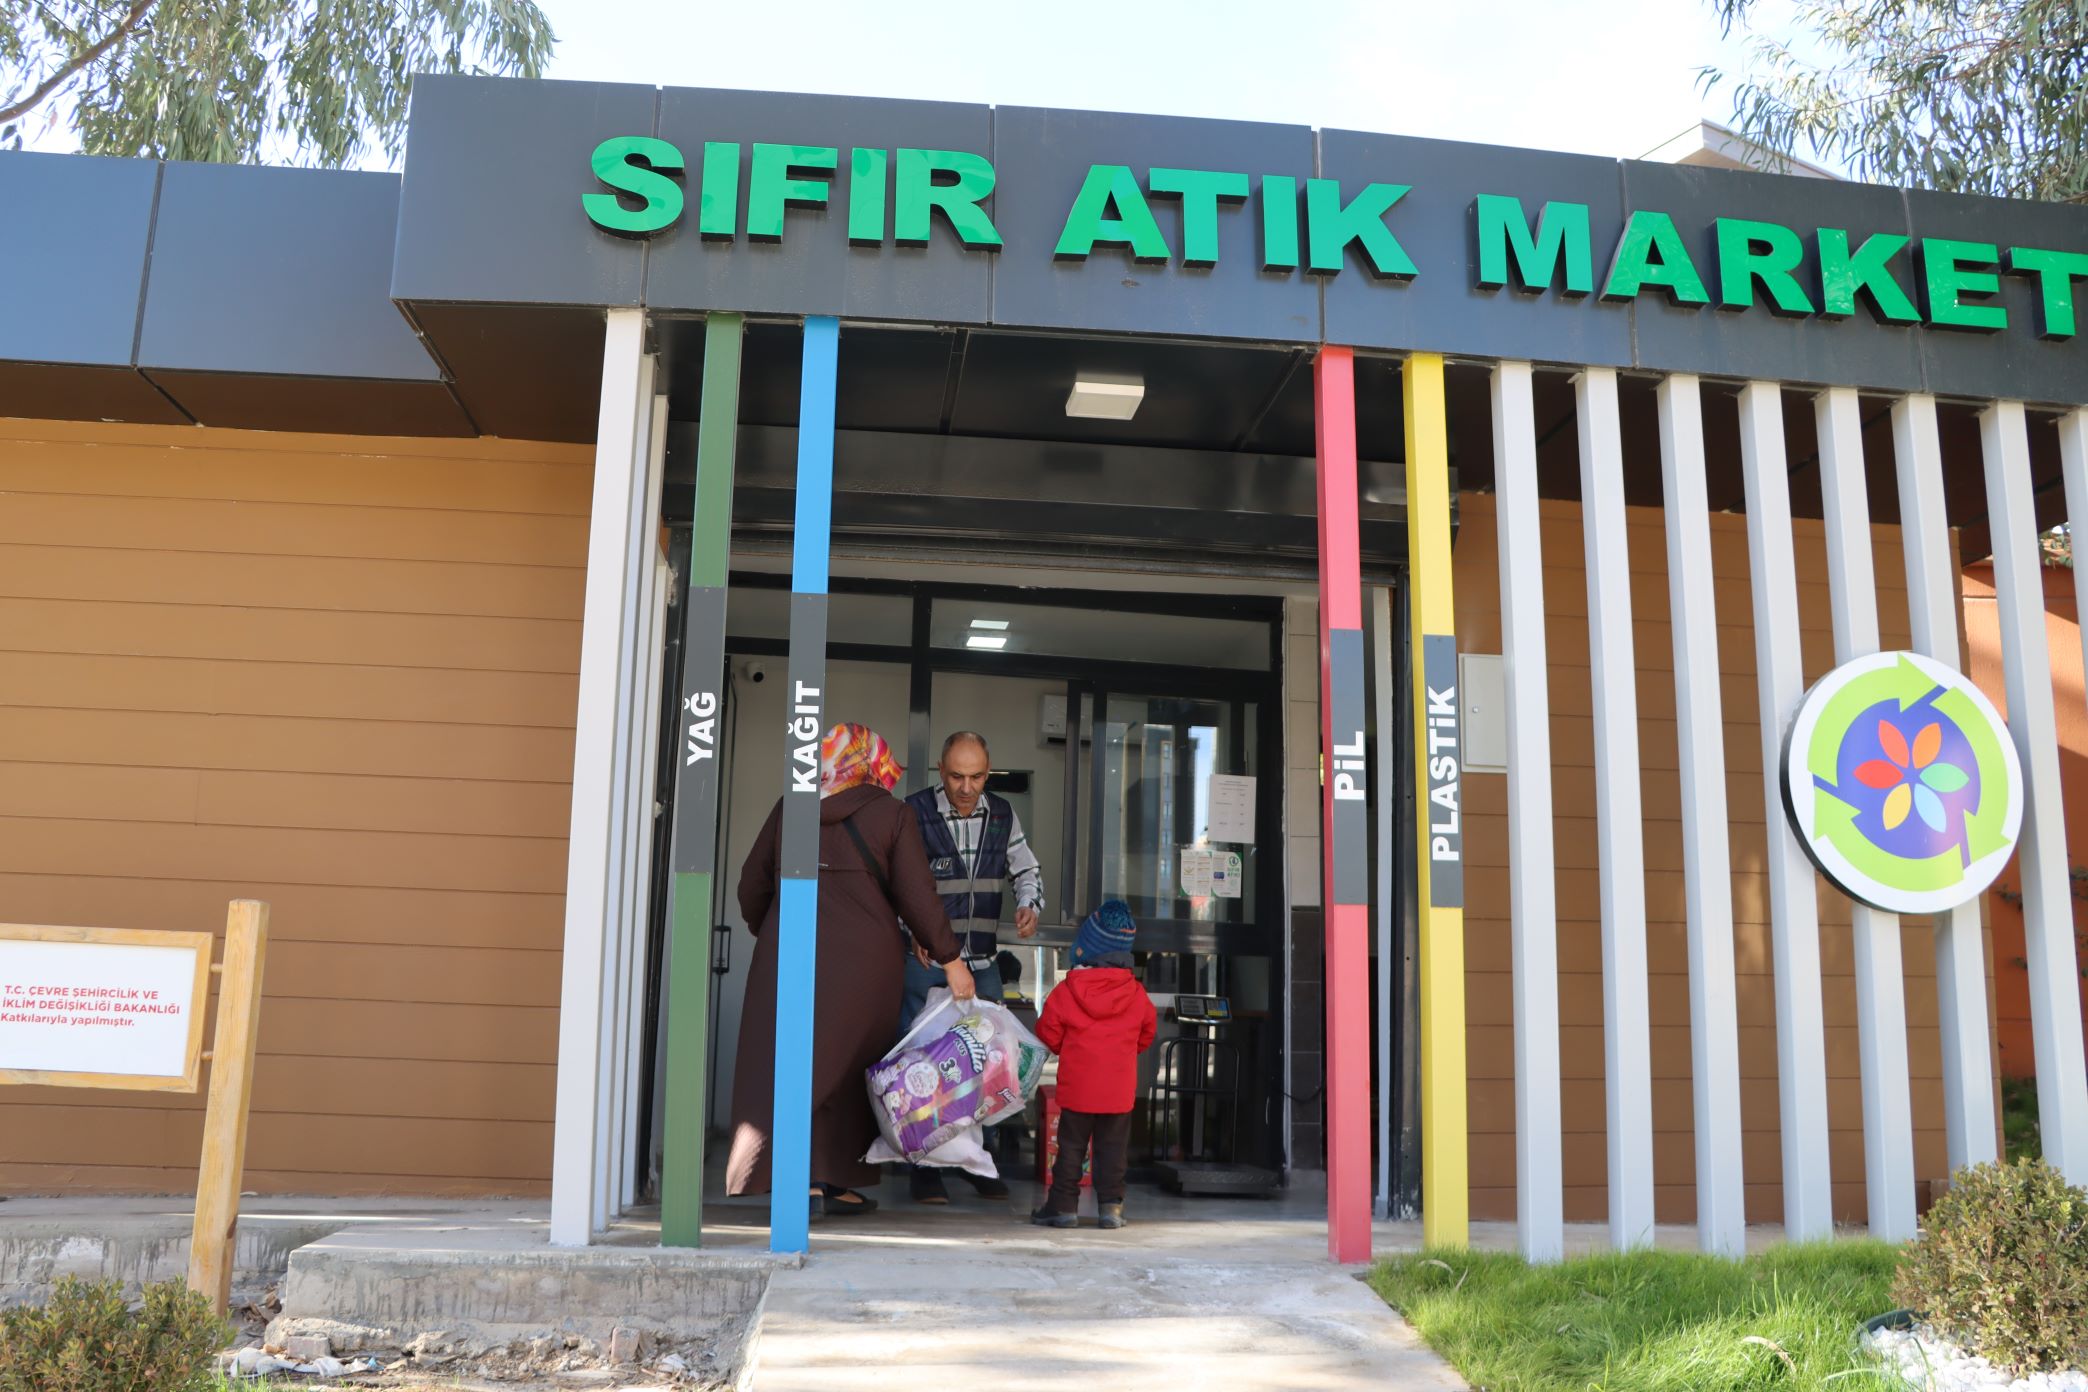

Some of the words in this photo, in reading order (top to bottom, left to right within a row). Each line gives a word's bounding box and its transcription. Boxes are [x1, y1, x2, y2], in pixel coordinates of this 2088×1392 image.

[582, 136, 1004, 250] SIFIR
[1053, 164, 1419, 280] ATIK
[1474, 193, 2088, 343] MARKET
[684, 692, 716, 767] YAĞ
[788, 681, 820, 792] KAĞIT
[3, 997, 35, 1009] İKLİM
[39, 999, 111, 1012] DEĞİŞİKLİĞİ
[114, 1002, 180, 1014] BAKANLIĞI
[4, 985, 25, 995] T.C.
[29, 986, 69, 996] ÇEVRE
[72, 986, 139, 998] ŞEHİRCİLİK
[143, 990, 159, 1000] VE
[1, 1012, 68, 1025] Katkılarıyla
[71, 1015, 135, 1027] yapılmıştır.
